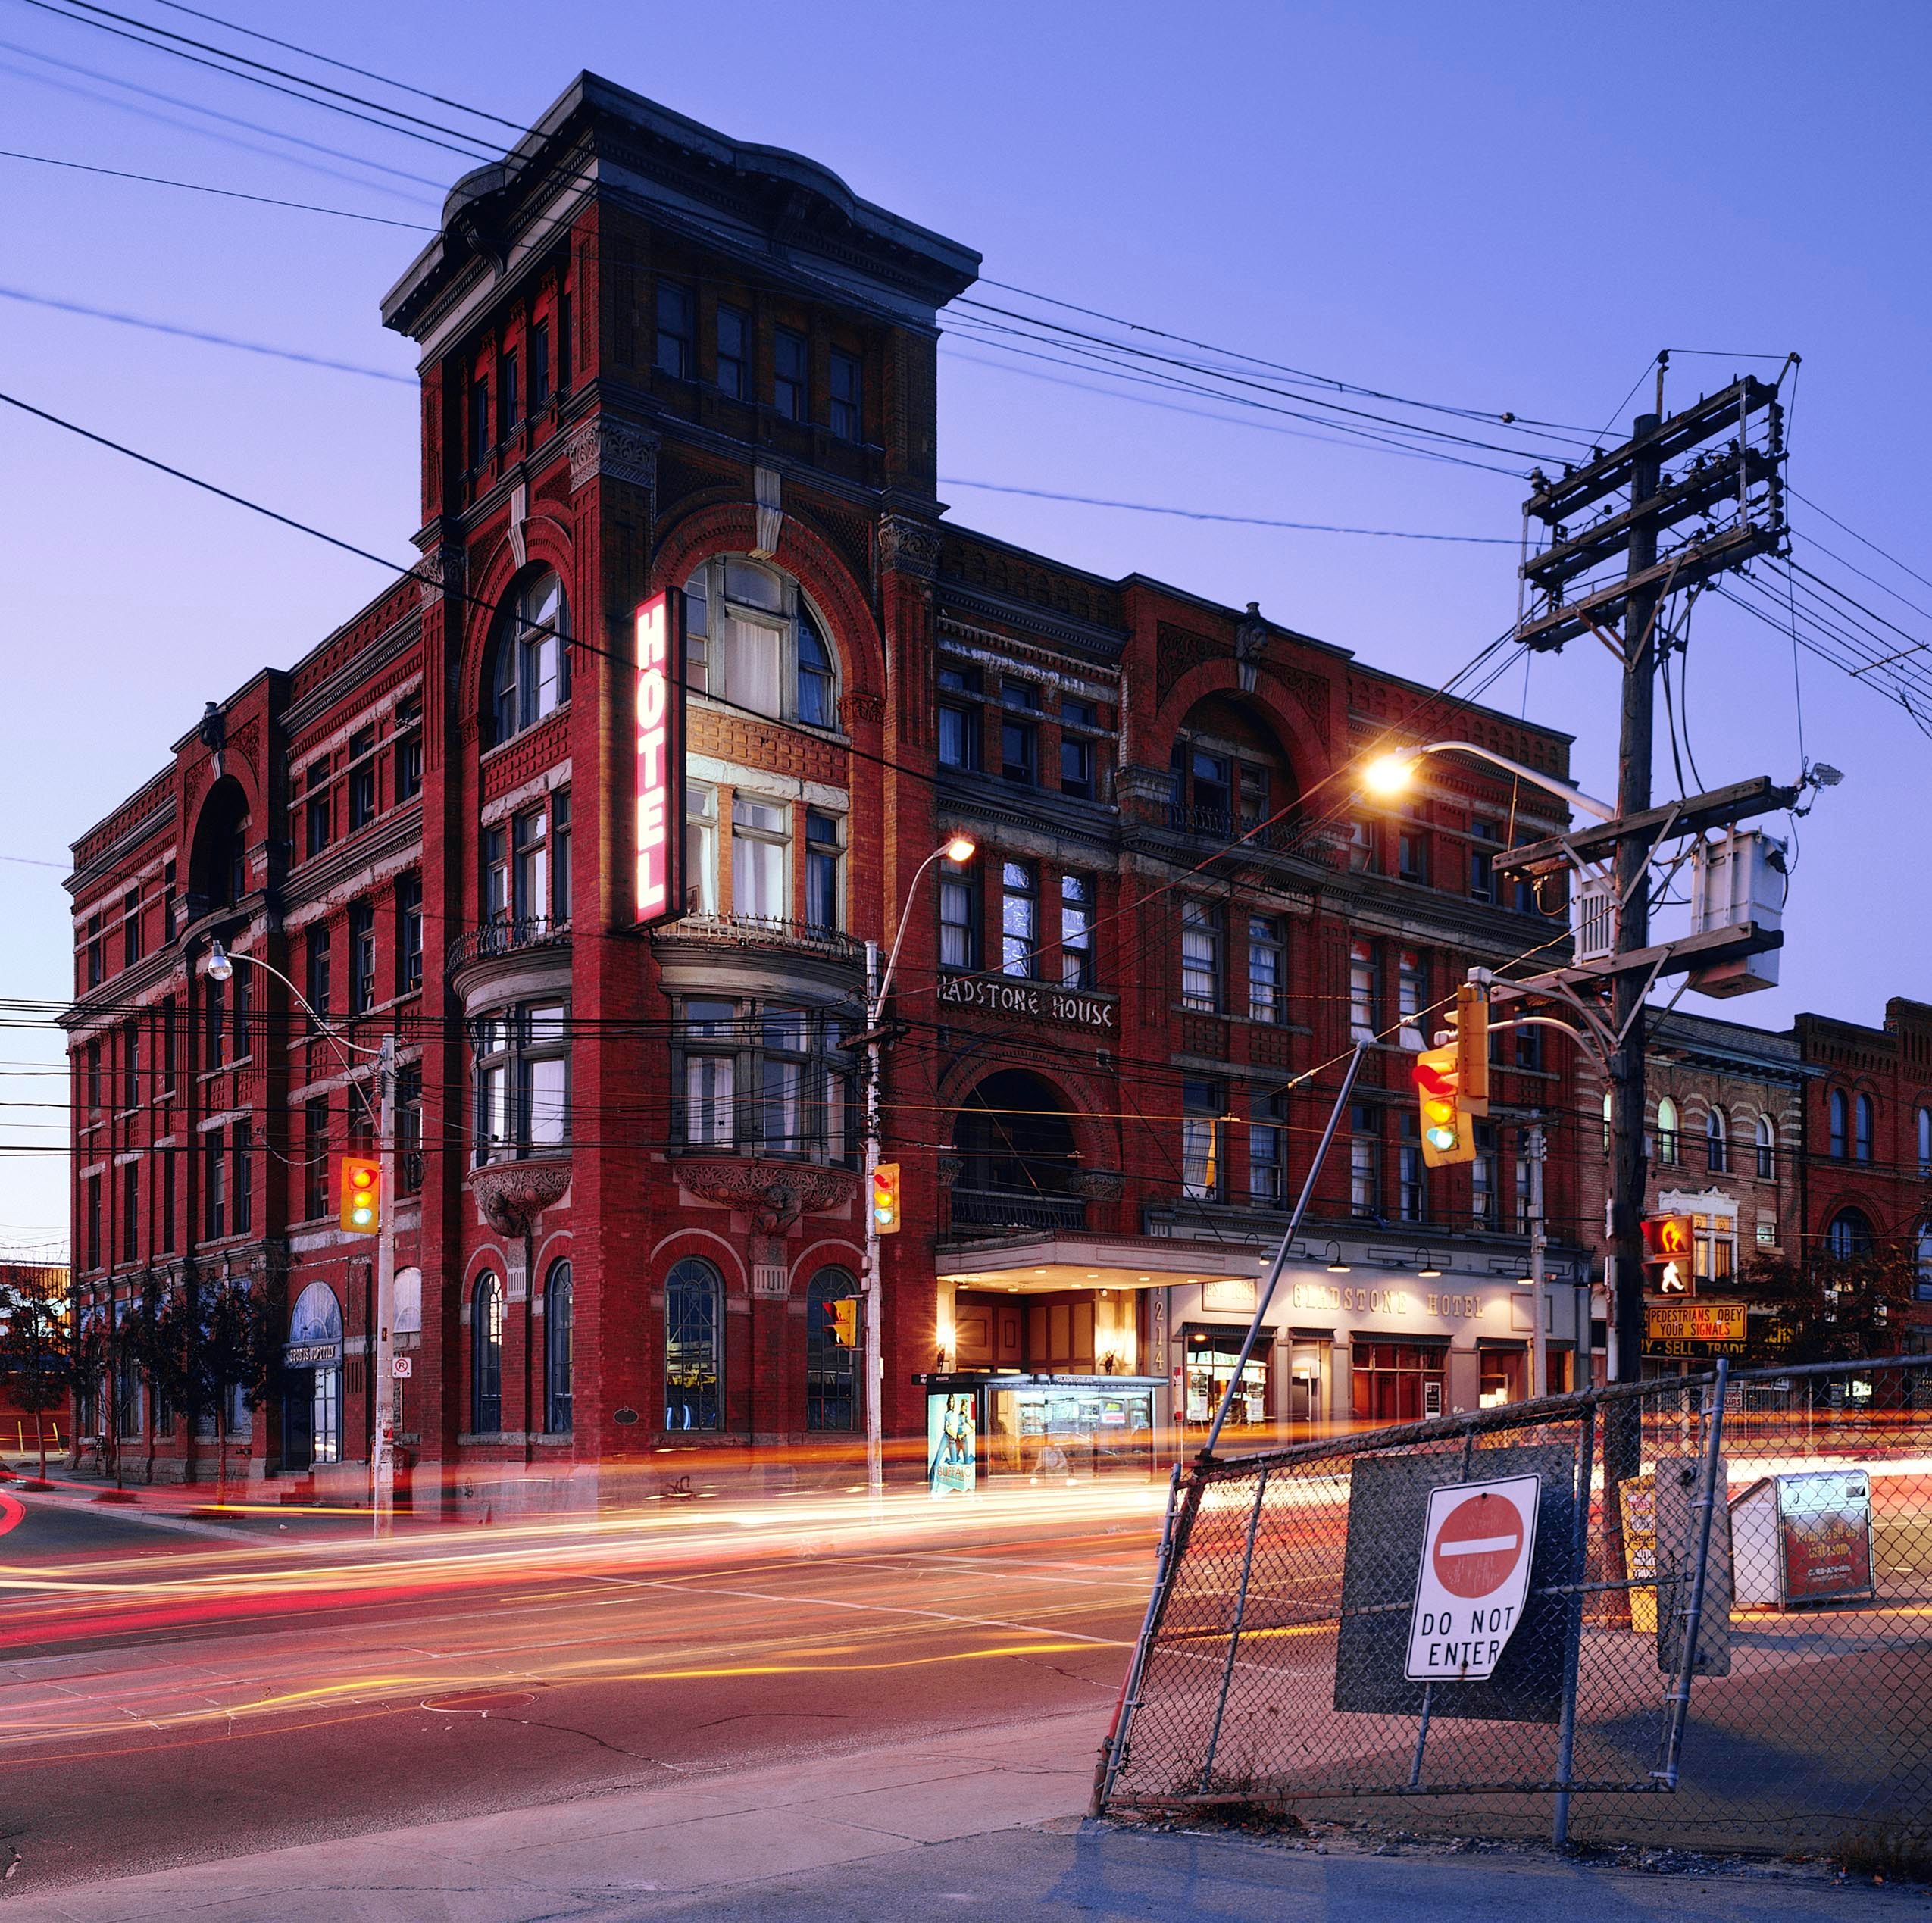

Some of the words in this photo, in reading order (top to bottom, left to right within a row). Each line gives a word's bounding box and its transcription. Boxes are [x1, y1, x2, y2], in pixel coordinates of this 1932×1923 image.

[637, 603, 665, 909] HOTEL
[936, 974, 1039, 1015] LADSTONE
[1052, 993, 1114, 1027] HOUSE
[1293, 1284, 1407, 1314] GLADSTONE
[1427, 1293, 1484, 1318] HOTEL
[1651, 1309, 1710, 1323] PEDESTRIANS
[1718, 1309, 1743, 1322] OBEY
[1660, 1323, 1684, 1336] YOUR
[1690, 1322, 1730, 1337] SIGNALS
[1665, 1341, 1694, 1355] SELL
[937, 1465, 972, 1477] BUFFALO
[1421, 1612, 1452, 1636] DO
[1471, 1606, 1515, 1634] NOT
[1428, 1640, 1500, 1666] ENTER
